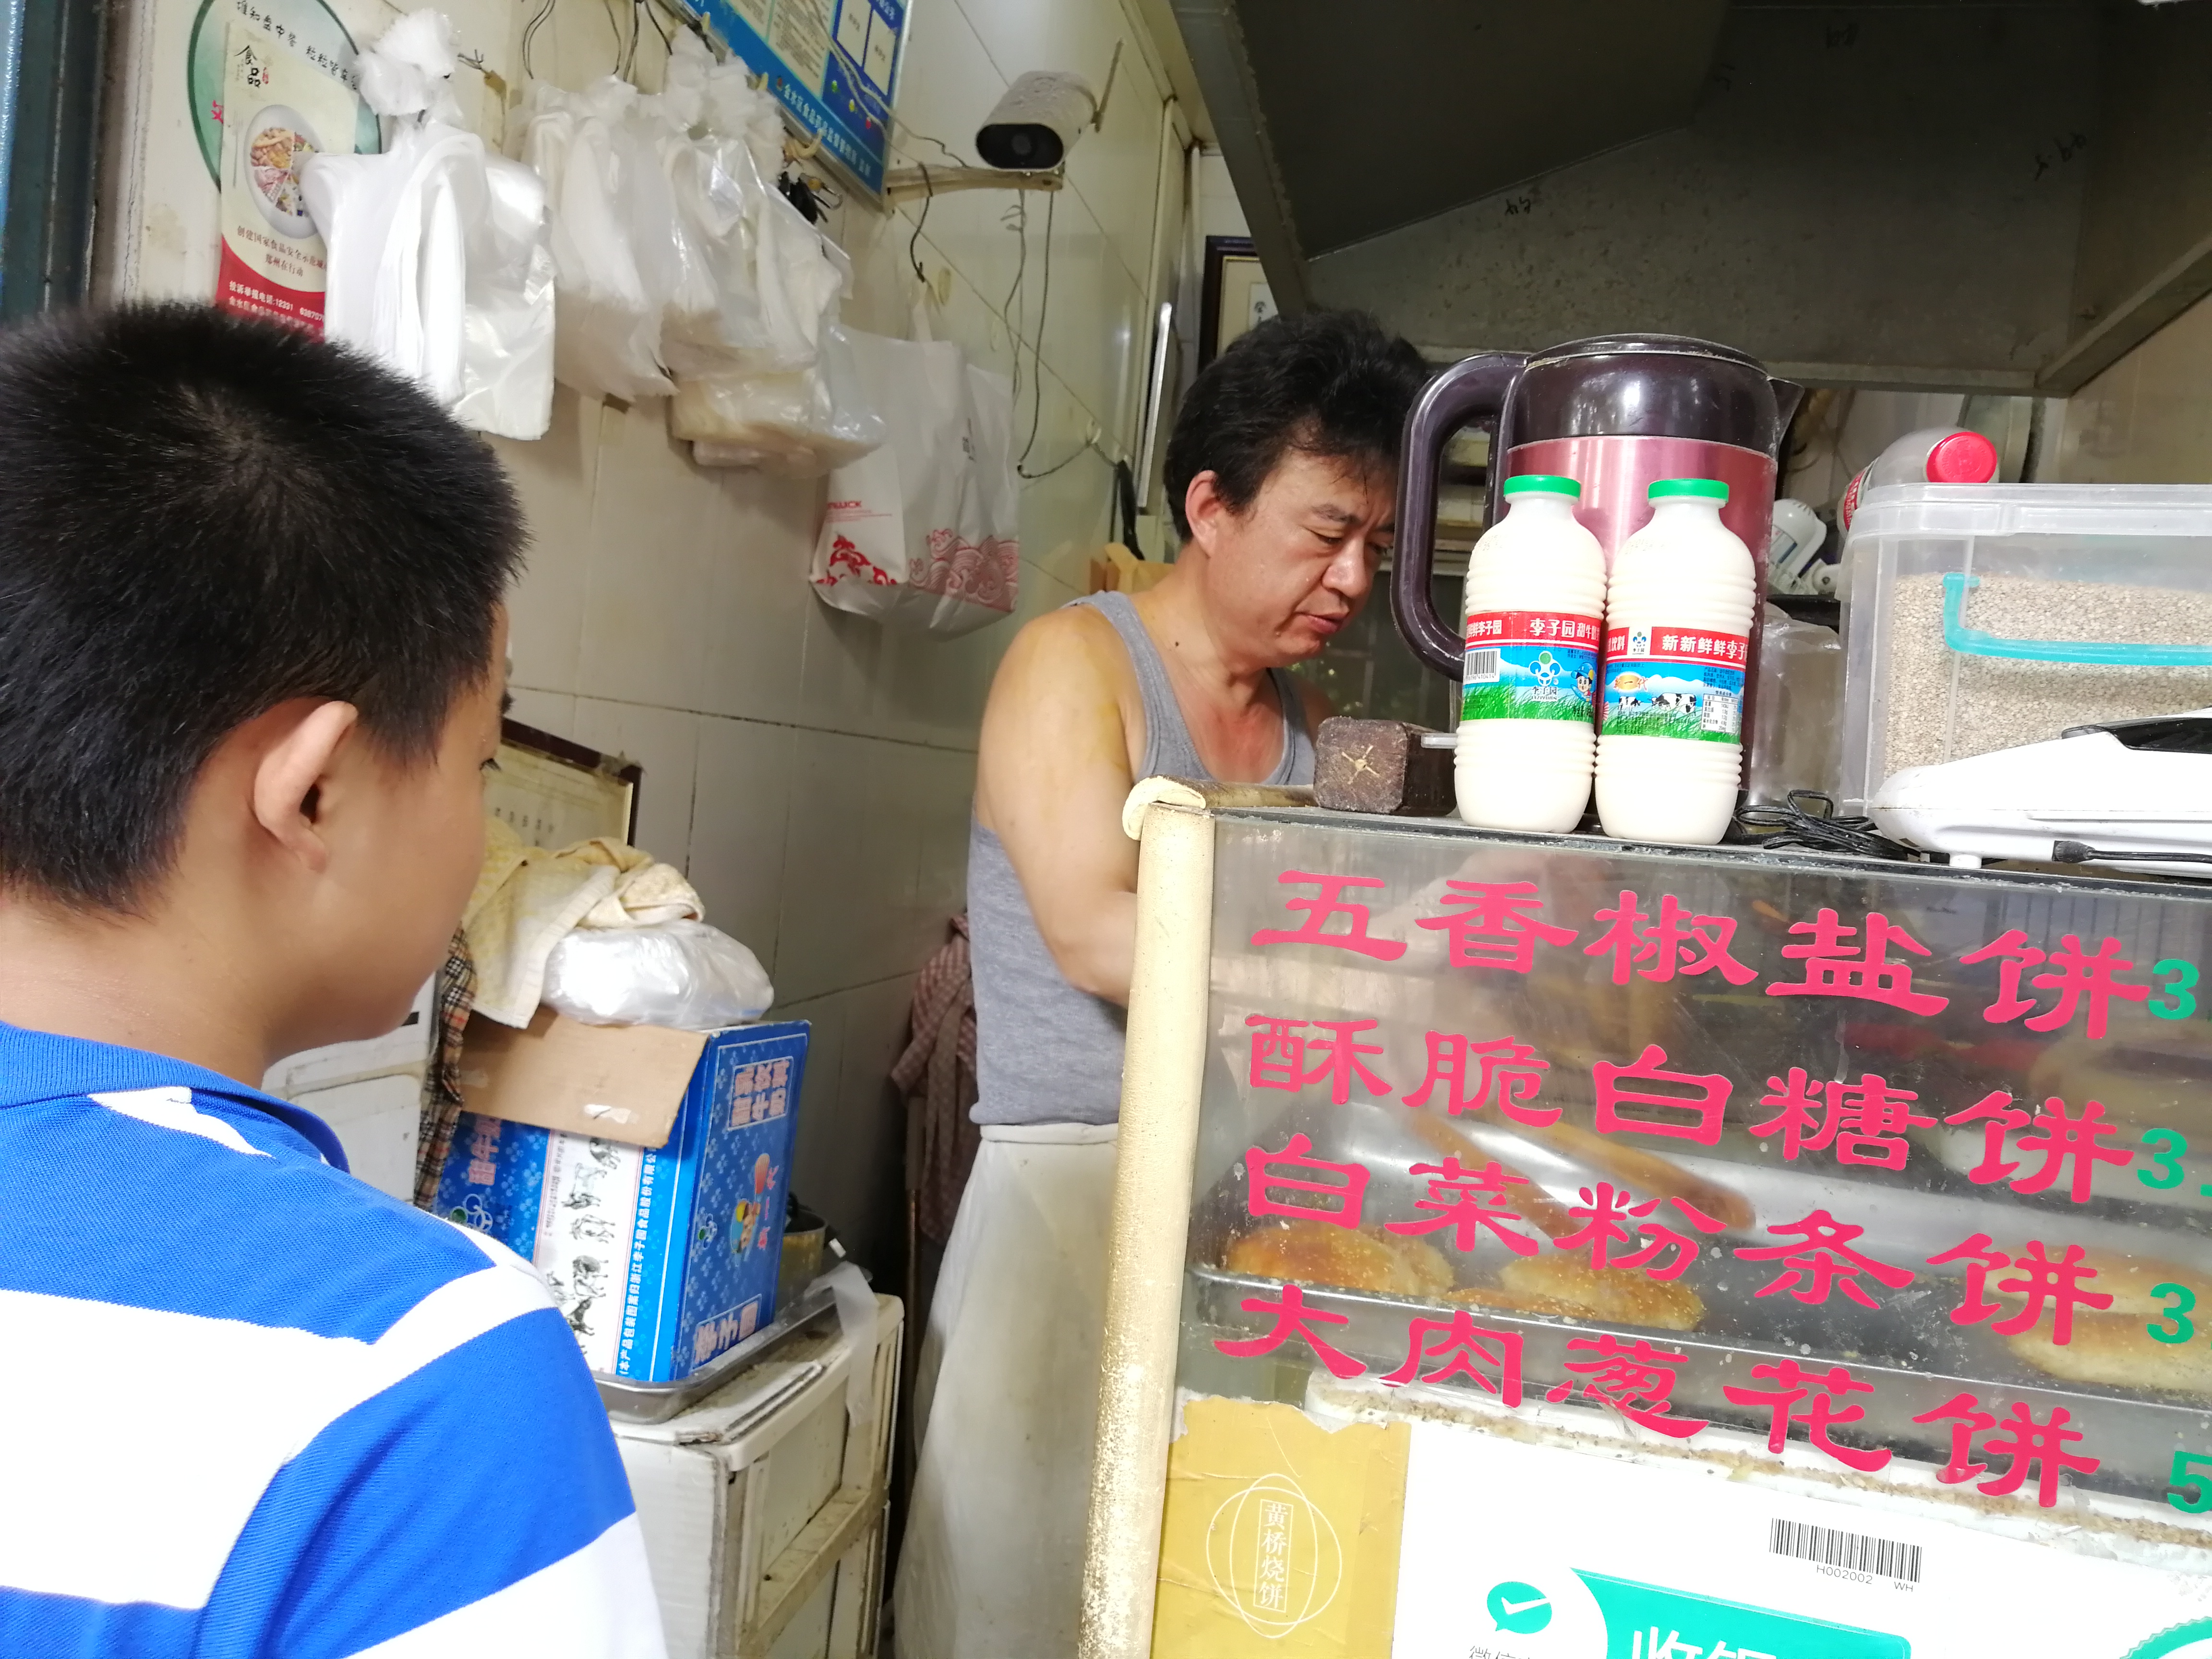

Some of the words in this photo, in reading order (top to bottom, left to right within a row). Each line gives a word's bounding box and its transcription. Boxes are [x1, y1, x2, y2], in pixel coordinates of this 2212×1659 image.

[235, 45, 261, 88] 食品
[265, 253, 303, 277] 郑州在行动
[1530, 618, 1575, 638] 李子园
[1662, 634, 1748, 661] 新新鲜鲜李子
[1532, 686, 1557, 695] 李子园
[1251, 871, 2150, 1039] 五香椒盐饼
[1246, 1015, 2134, 1202] 酥脆白糖饼
[1246, 1134, 2113, 1345] 白菜粉条饼
[1215, 1285, 2100, 1507] 大肉葱花饼
[1259, 1503, 1288, 1609] 黄桥烧饼
[1816, 1564, 1873, 1584] H002002
[1894, 1581, 1913, 1592] WH
